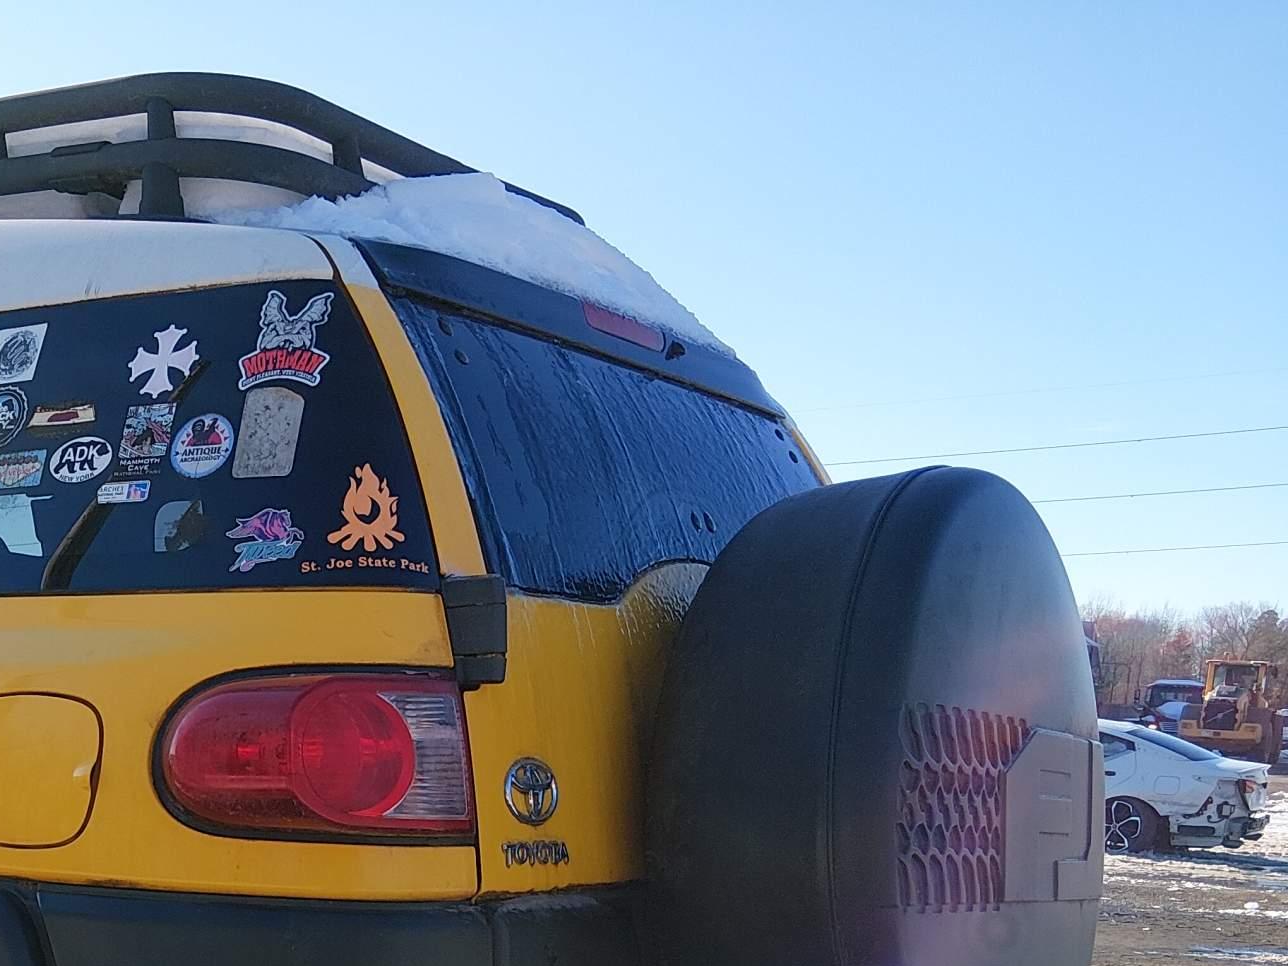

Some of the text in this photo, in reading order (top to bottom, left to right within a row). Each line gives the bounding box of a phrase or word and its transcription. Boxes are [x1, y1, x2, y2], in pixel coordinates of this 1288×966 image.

[243, 348, 325, 378] MOTHMAN
[62, 445, 101, 463] ADK
[181, 446, 222, 457] ANTIQUE
[119, 458, 161, 466] MAMMOTH
[58, 472, 95, 482] NEW YORK
[301, 556, 430, 574] St. Joe State Park
[501, 840, 569, 868] TOYOTA
